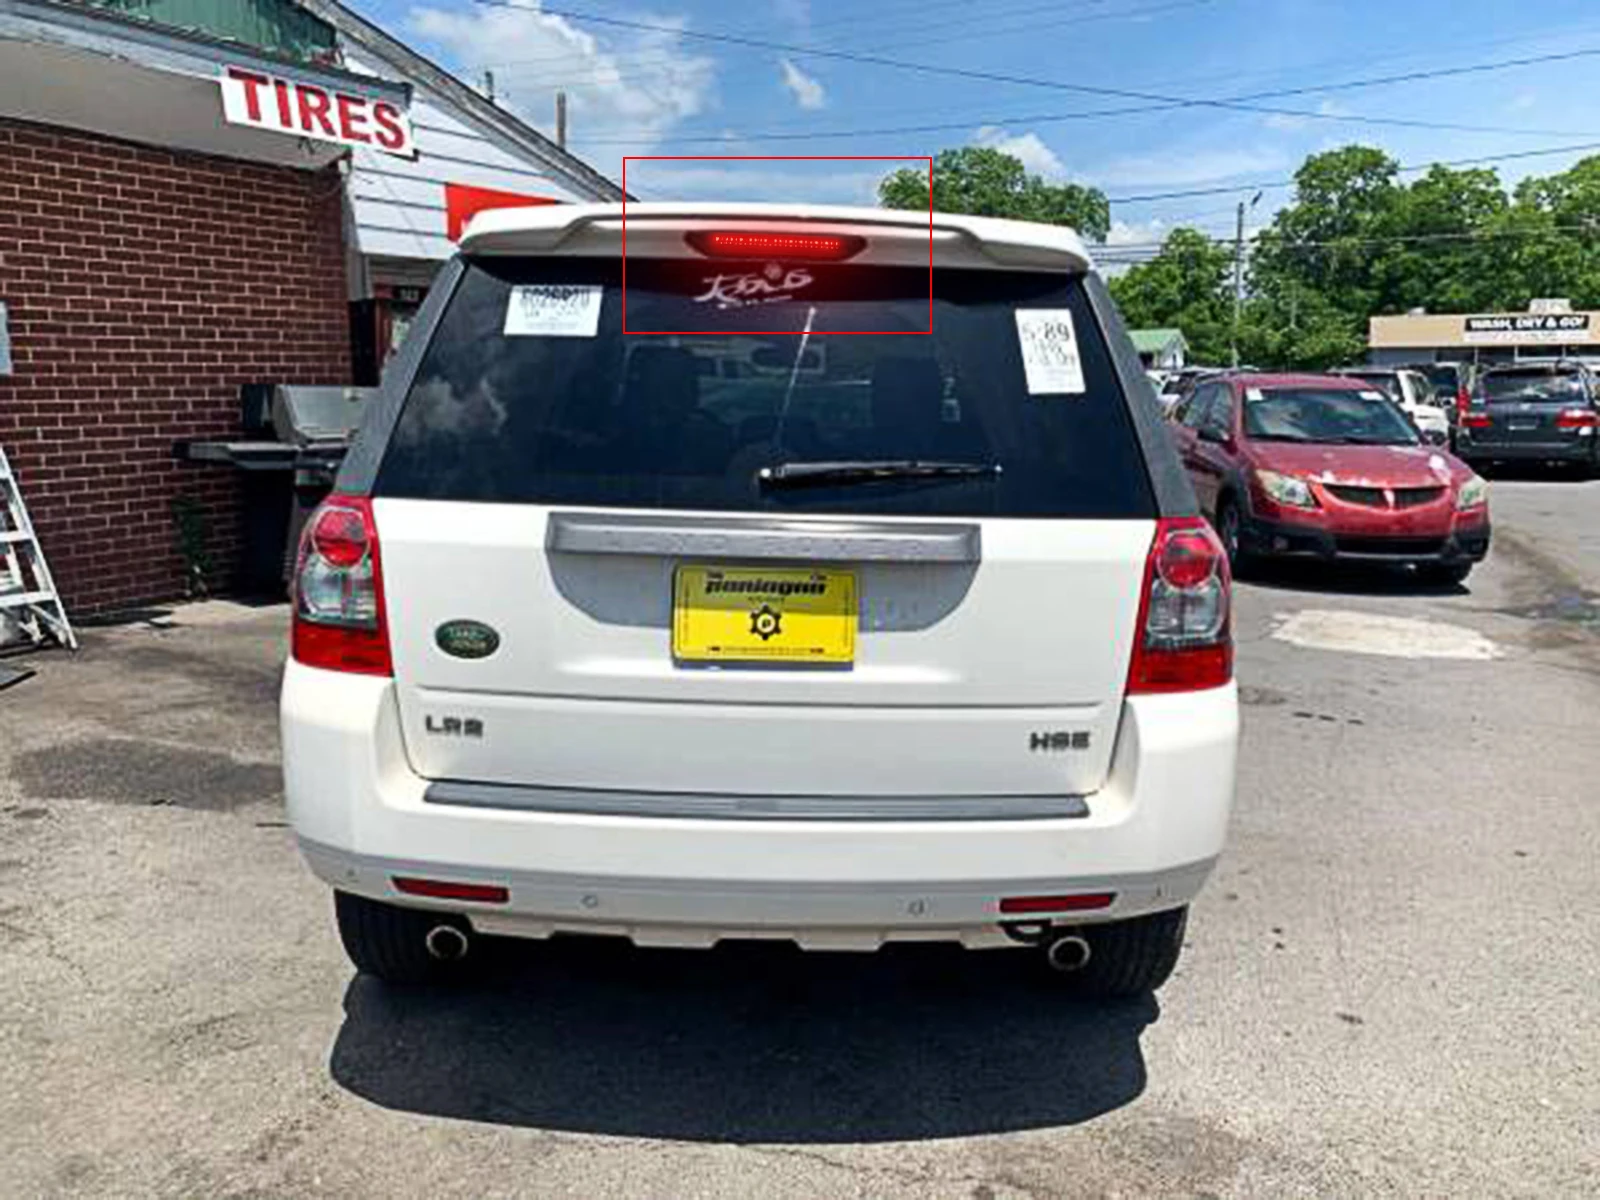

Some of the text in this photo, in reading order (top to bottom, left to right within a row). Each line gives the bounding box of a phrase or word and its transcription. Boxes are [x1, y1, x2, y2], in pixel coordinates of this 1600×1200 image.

[227, 67, 405, 149] TIRES
[1516, 317, 1544, 329] DRY
[1545, 317, 1558, 329] &
[1030, 731, 1090, 751] HSE
